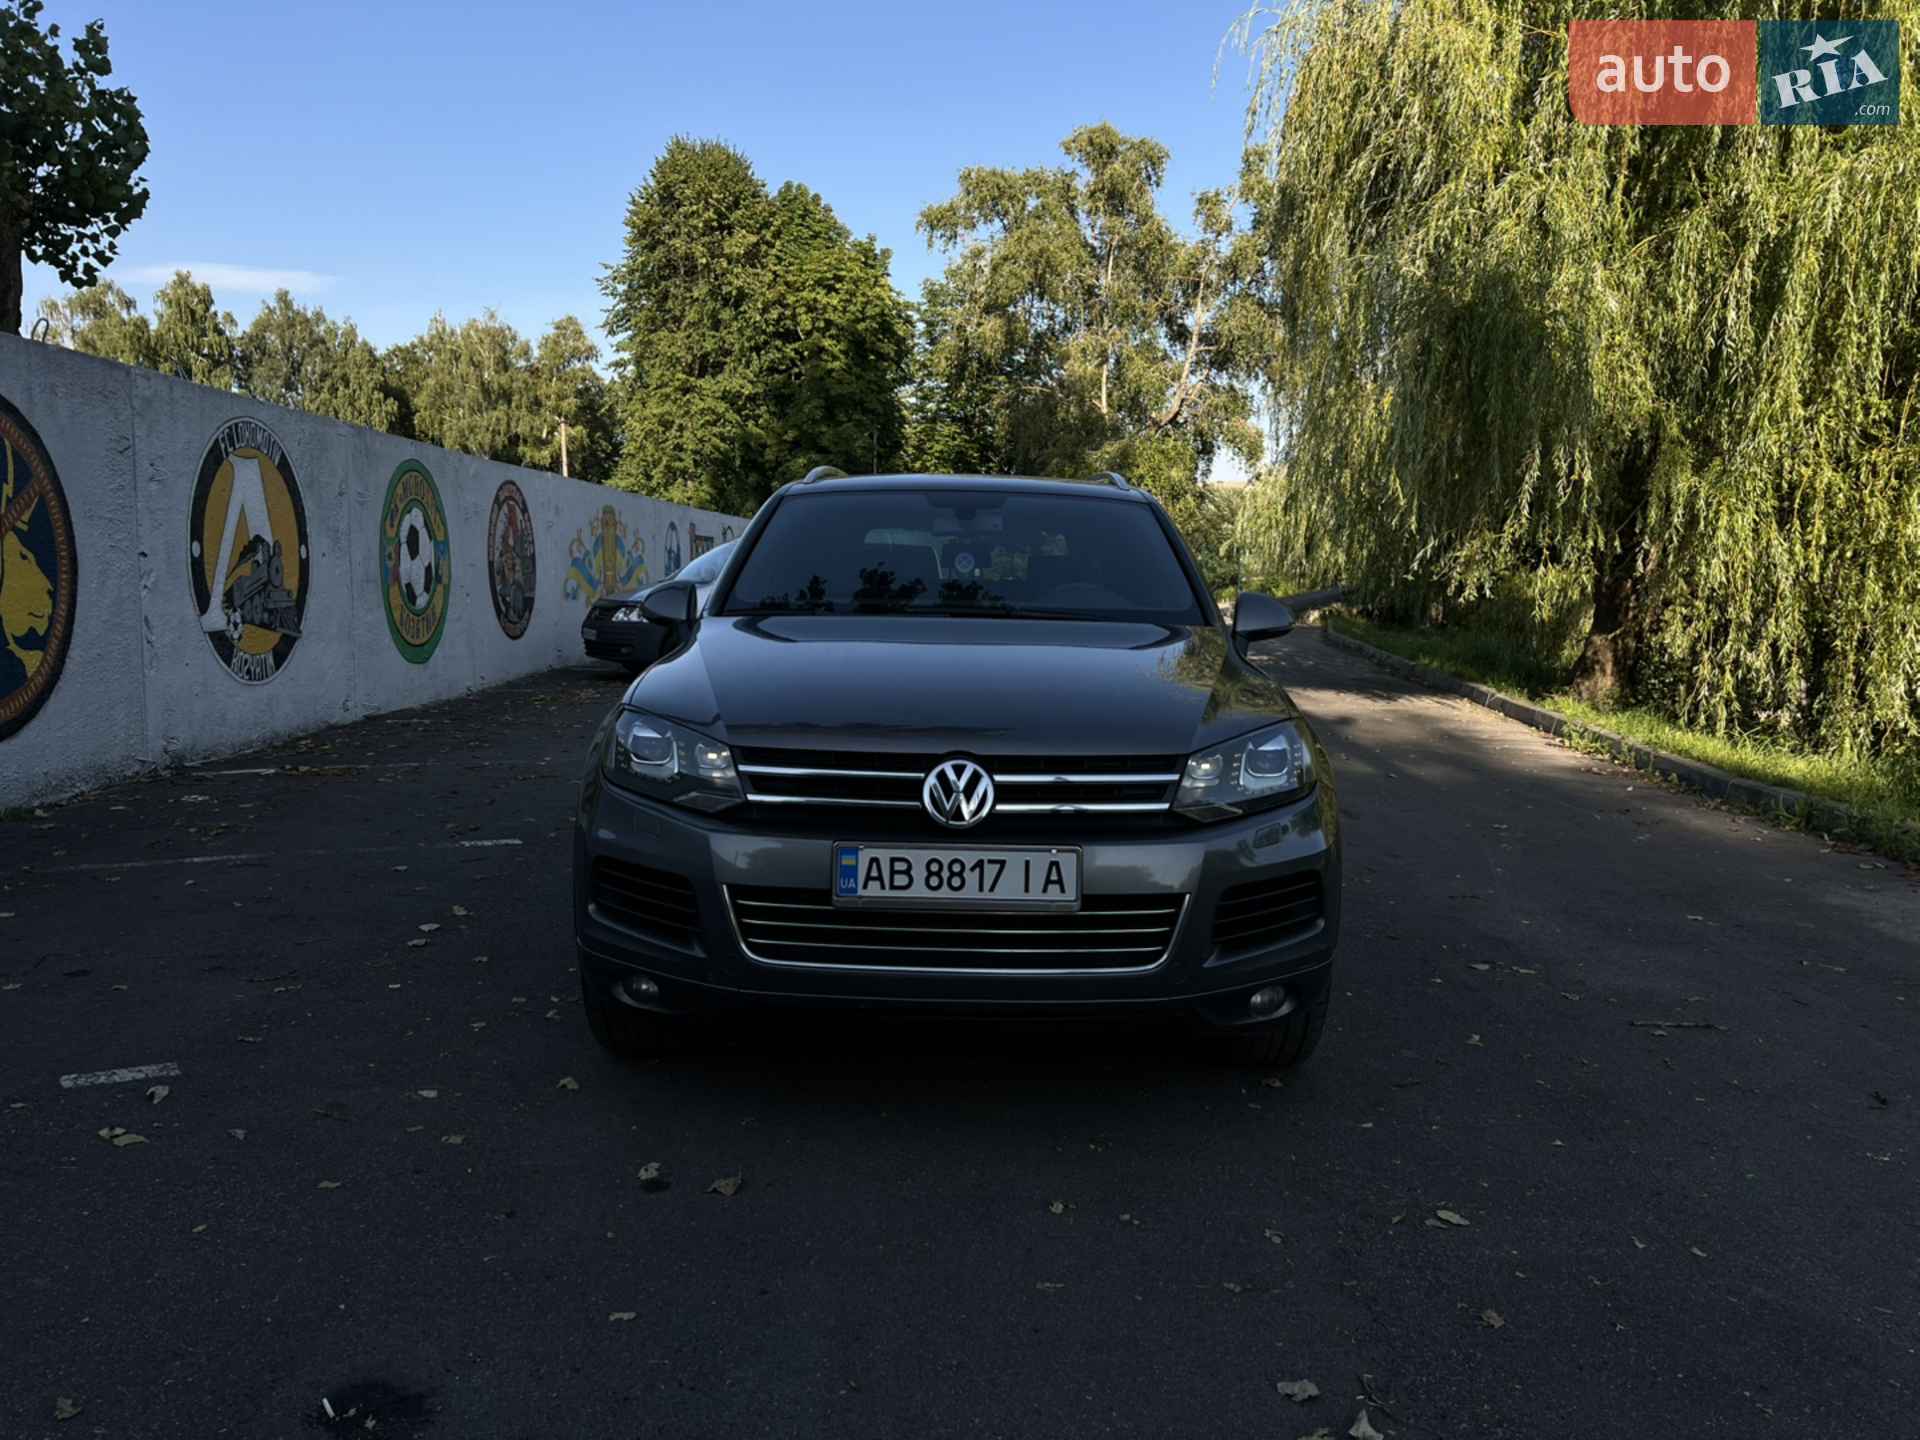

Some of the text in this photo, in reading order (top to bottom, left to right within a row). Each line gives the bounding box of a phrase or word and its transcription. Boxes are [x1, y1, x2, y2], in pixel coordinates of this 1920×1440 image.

[840, 877, 857, 890] UA
[862, 857, 1067, 895] AB 8817 IA
